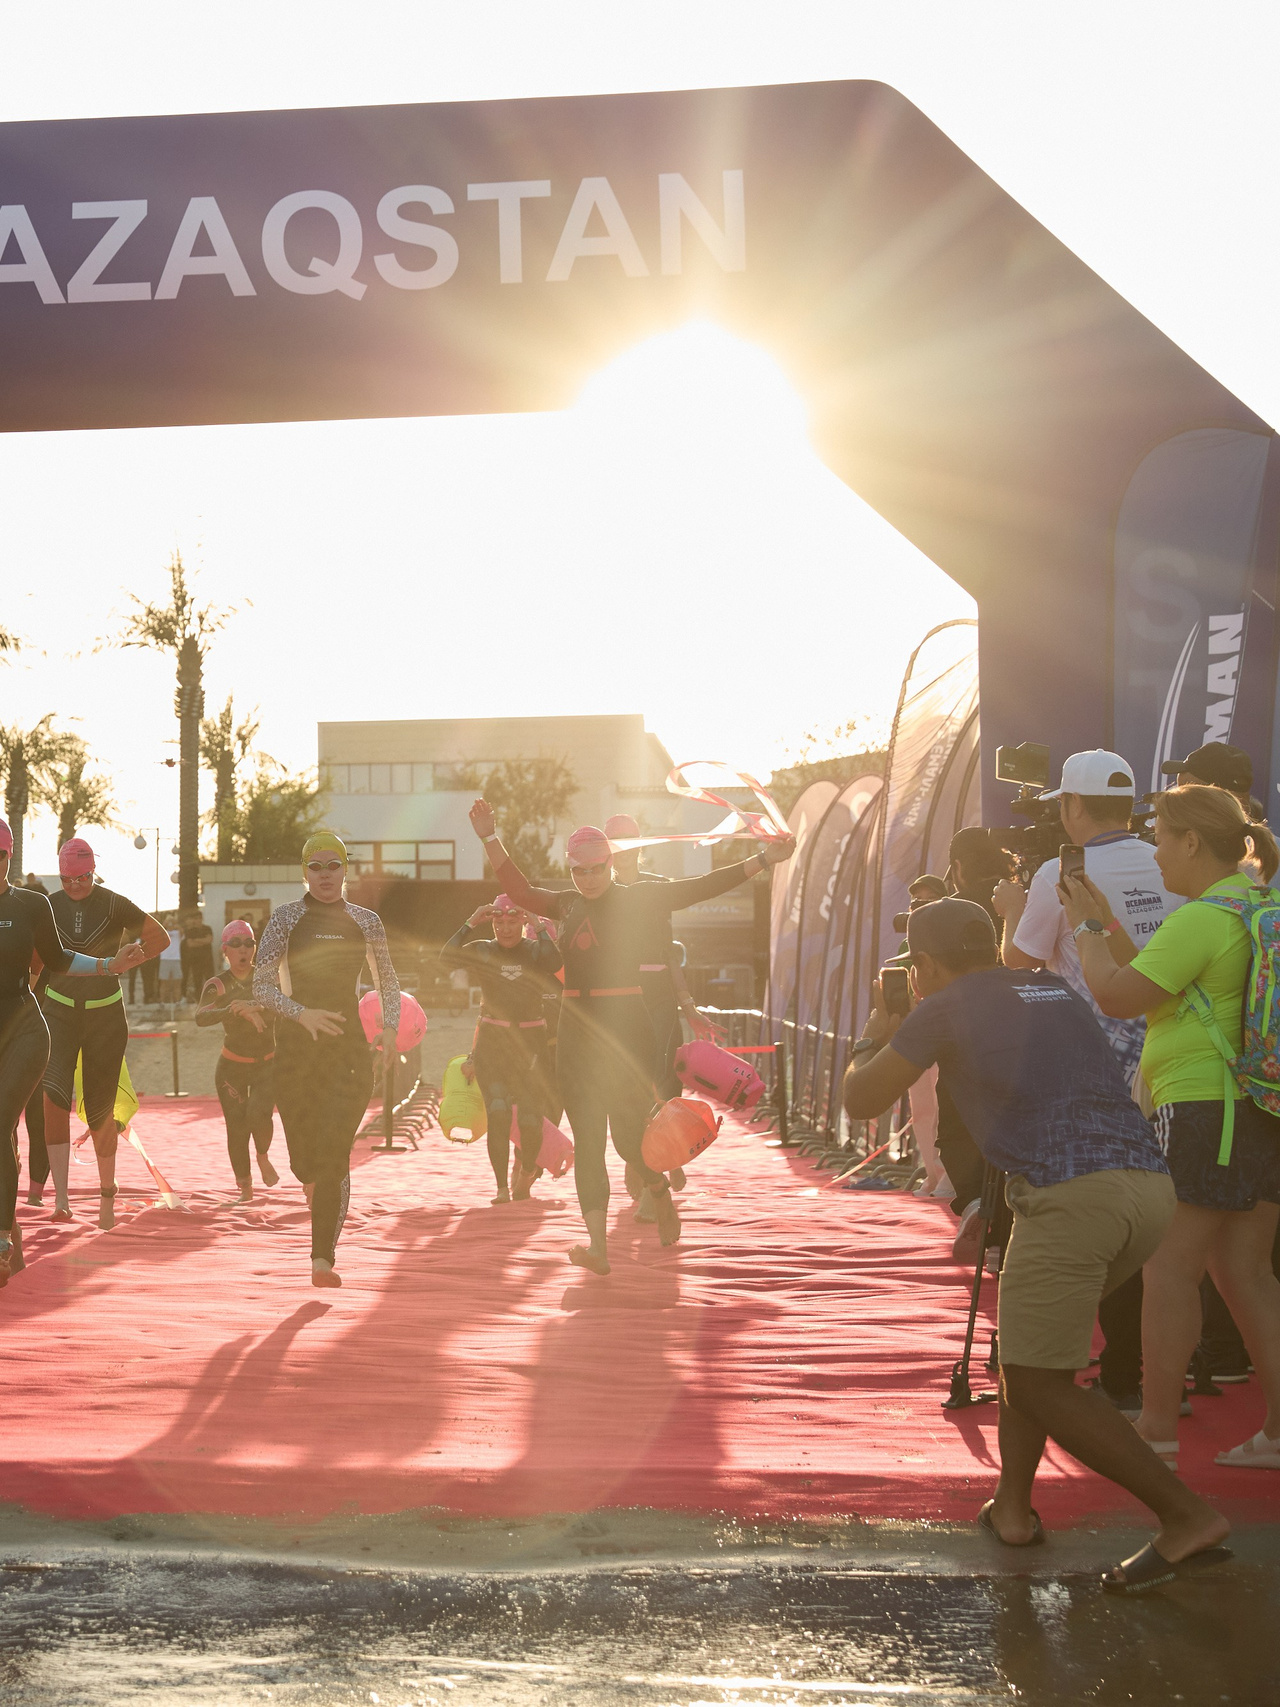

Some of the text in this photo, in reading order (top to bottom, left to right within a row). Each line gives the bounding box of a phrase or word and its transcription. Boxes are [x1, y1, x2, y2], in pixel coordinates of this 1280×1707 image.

[1125, 896, 1162, 908] OCEANMAN
[1127, 906, 1164, 915] QAZAQSTAN
[1018, 989, 1068, 998] OCEANMAN
[733, 1066, 752, 1080] 717
